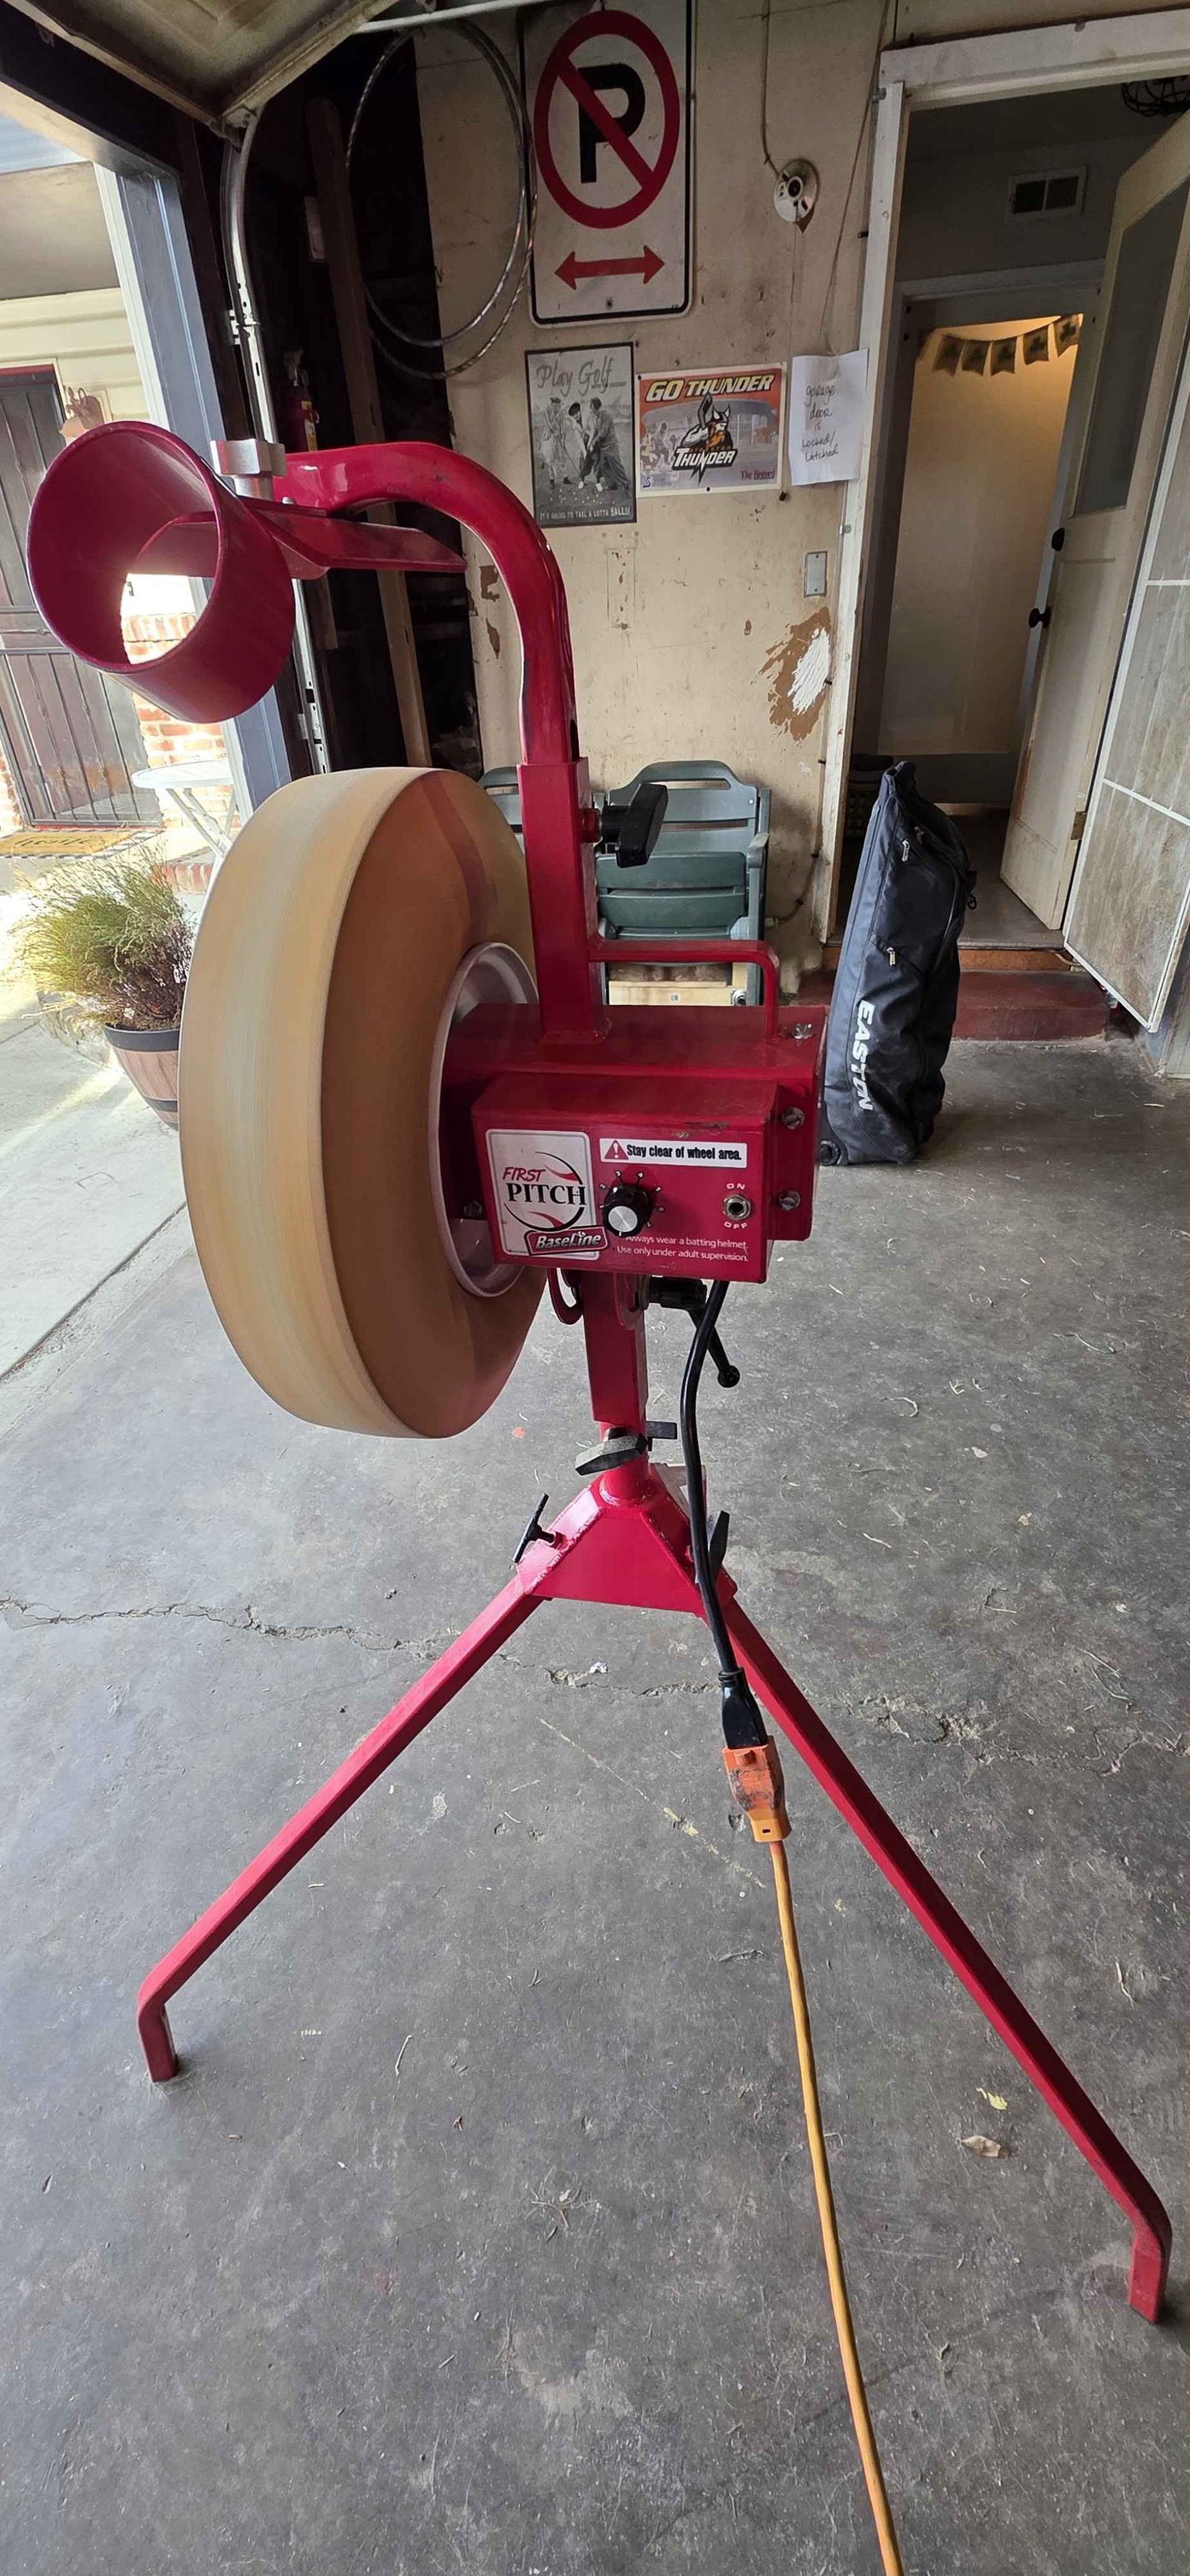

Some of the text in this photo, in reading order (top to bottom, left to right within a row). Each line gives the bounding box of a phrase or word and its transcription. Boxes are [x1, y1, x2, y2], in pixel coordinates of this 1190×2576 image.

[577, 63, 645, 184] P
[536, 356, 614, 397] Play Golf
[645, 374, 775, 402] GO THUNDER
[739, 470, 752, 480] The
[851, 999, 875, 1111] EASTON
[627, 1144, 742, 1160] Stay clear of wheel area.
[503, 1166, 546, 1182] FIRST
[506, 1182, 586, 1205] PITCH
[535, 1231, 601, 1249] BaseLine
[686, 1236, 716, 1248] batting
[633, 1247, 651, 1257] only
[651, 1248, 676, 1257] under
[678, 1249, 699, 1259] adult
[701, 1252, 748, 1261] supervision.
